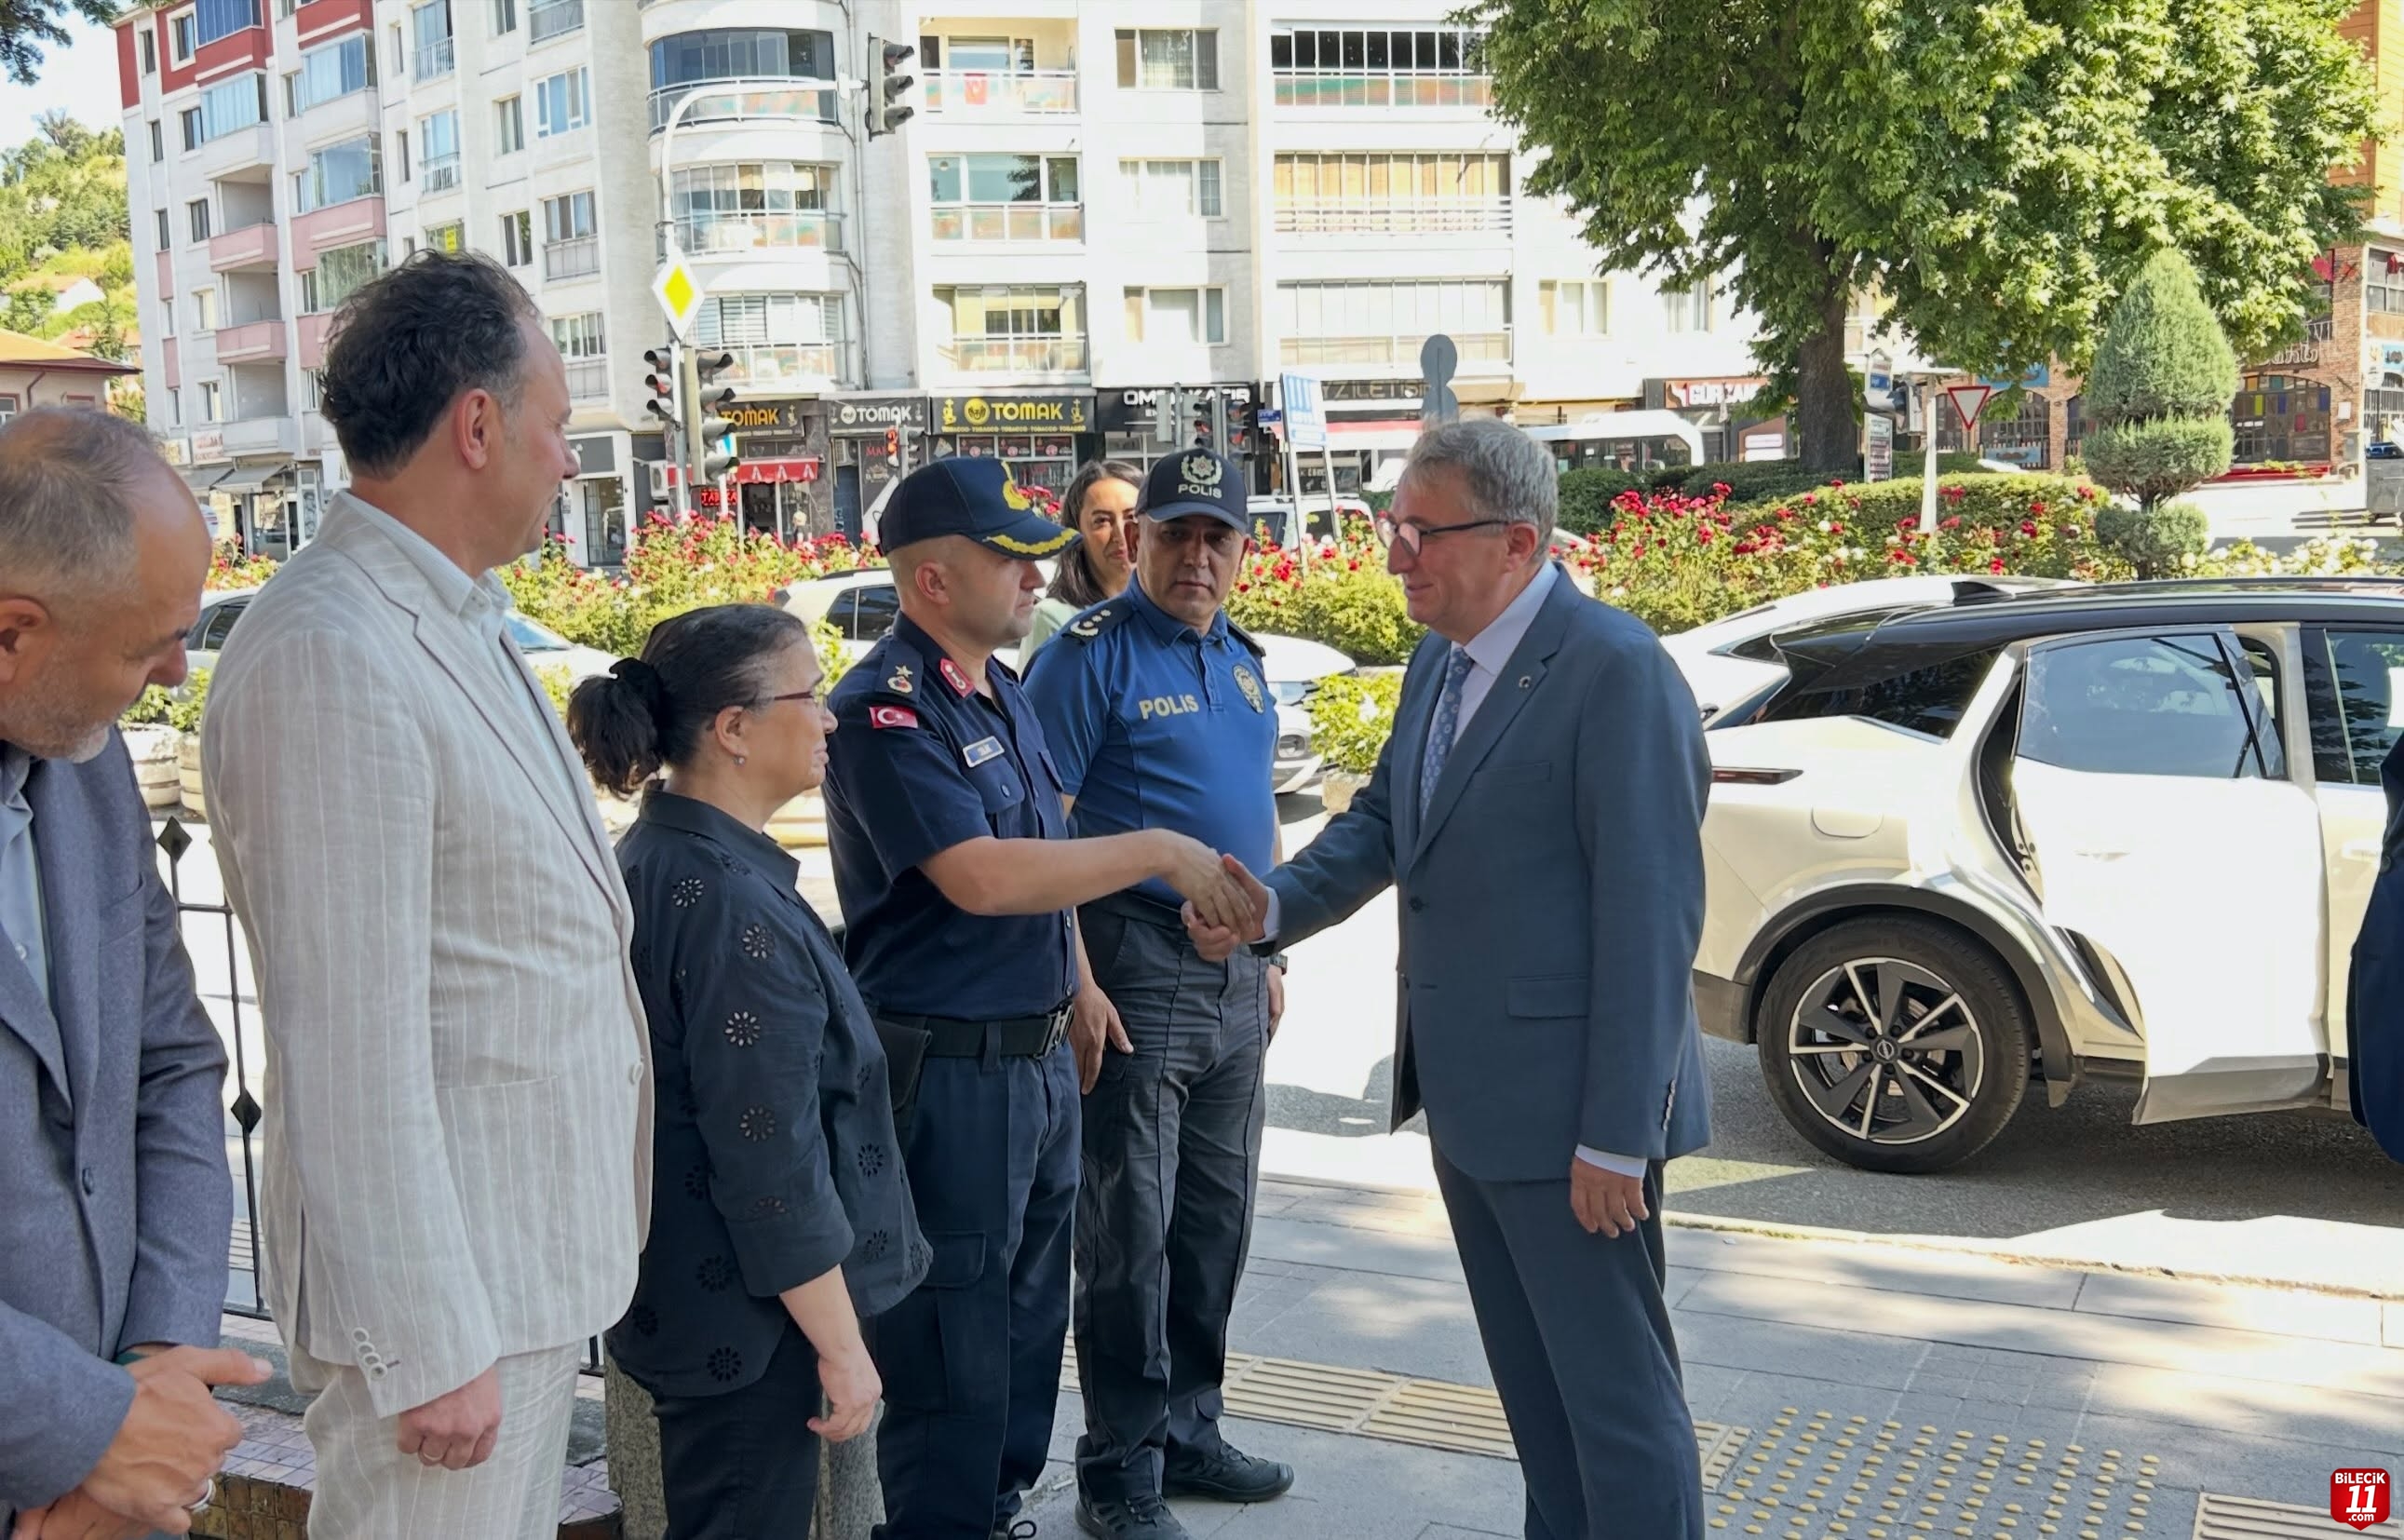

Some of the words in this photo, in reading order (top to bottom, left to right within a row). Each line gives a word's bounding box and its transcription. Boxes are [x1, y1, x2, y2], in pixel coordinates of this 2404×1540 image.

[721, 409, 779, 426] TOMAK
[856, 406, 912, 422] TOMAK
[991, 402, 1063, 420] TOMAK
